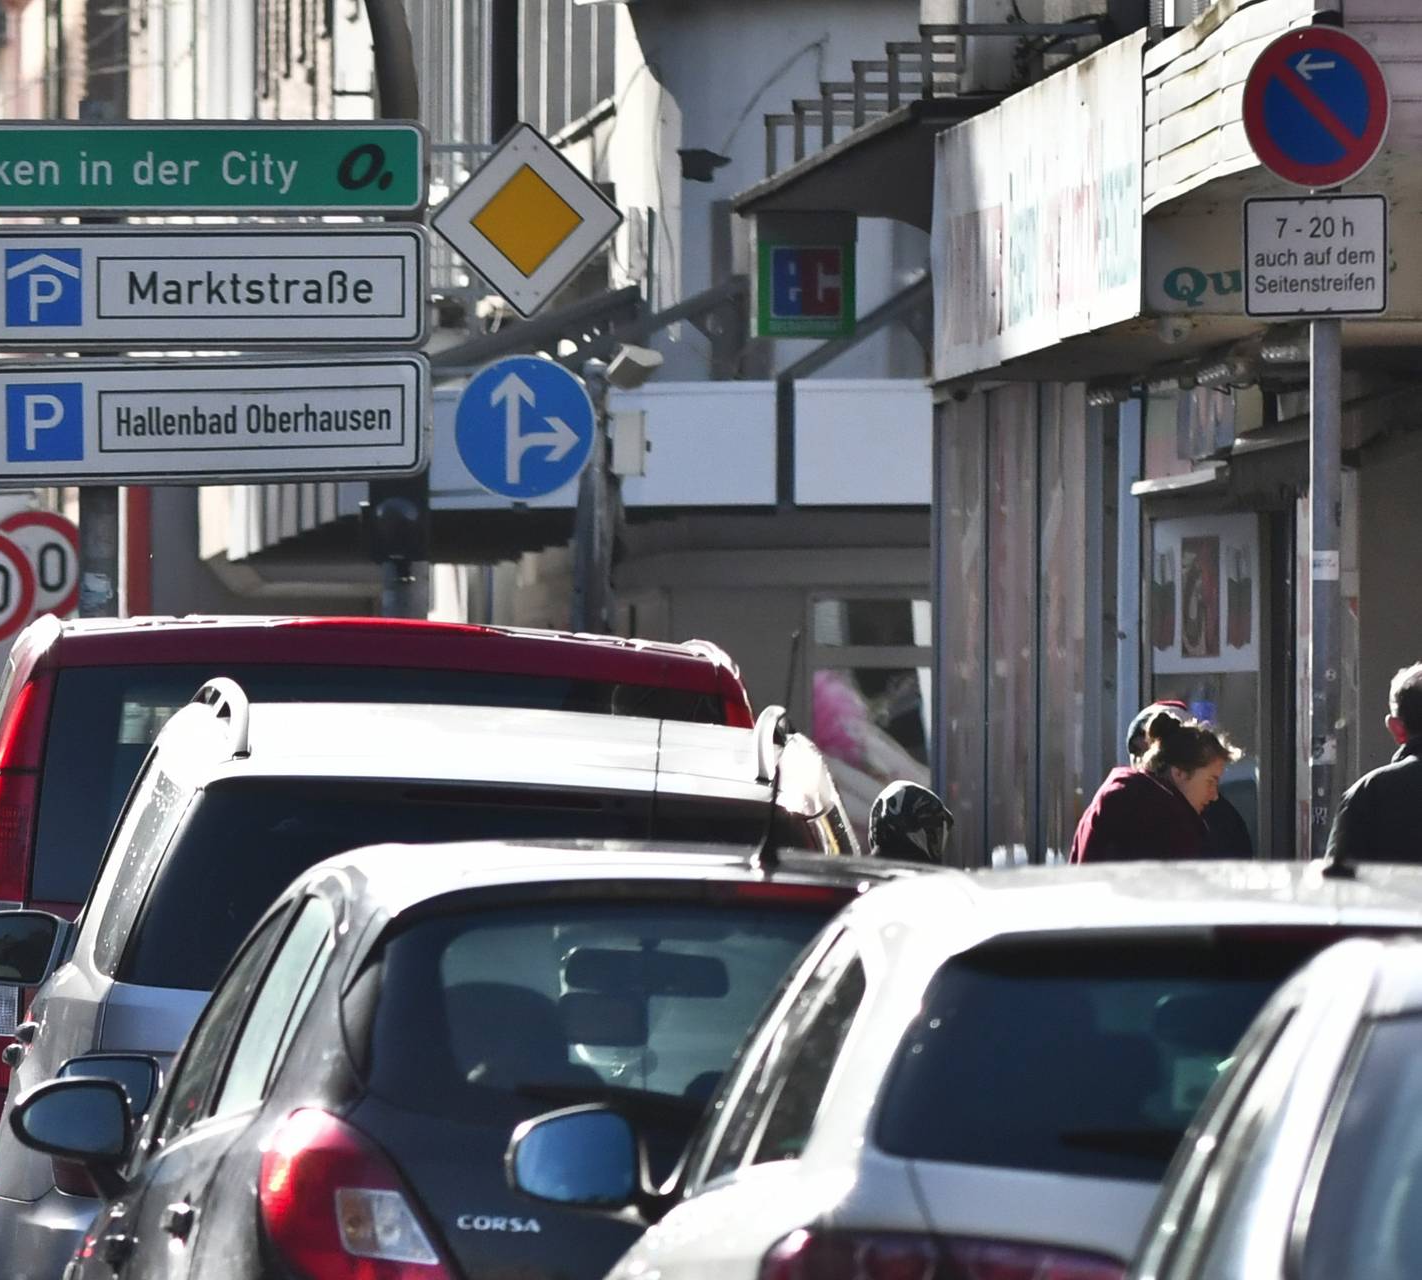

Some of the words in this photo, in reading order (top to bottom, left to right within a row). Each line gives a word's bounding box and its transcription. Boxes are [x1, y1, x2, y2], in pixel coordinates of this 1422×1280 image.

[80, 151, 113, 186] in
[133, 151, 200, 186] der
[221, 150, 298, 194] City
[1276, 217, 1288, 239] 7
[1309, 216, 1335, 239] 20
[1342, 216, 1354, 237] h
[1254, 249, 1297, 268] auch
[1304, 247, 1332, 266] auf
[1337, 248, 1375, 266] dem
[28, 274, 64, 322] P
[128, 270, 374, 306] Marktstraße
[1254, 273, 1375, 294] Seitenstreifen
[24, 394, 65, 450] P
[116, 405, 238, 437] Hallenbad
[246, 403, 391, 434] Oberhausen
[38, 542, 66, 592] 0
[457, 1214, 540, 1233] CORSA
